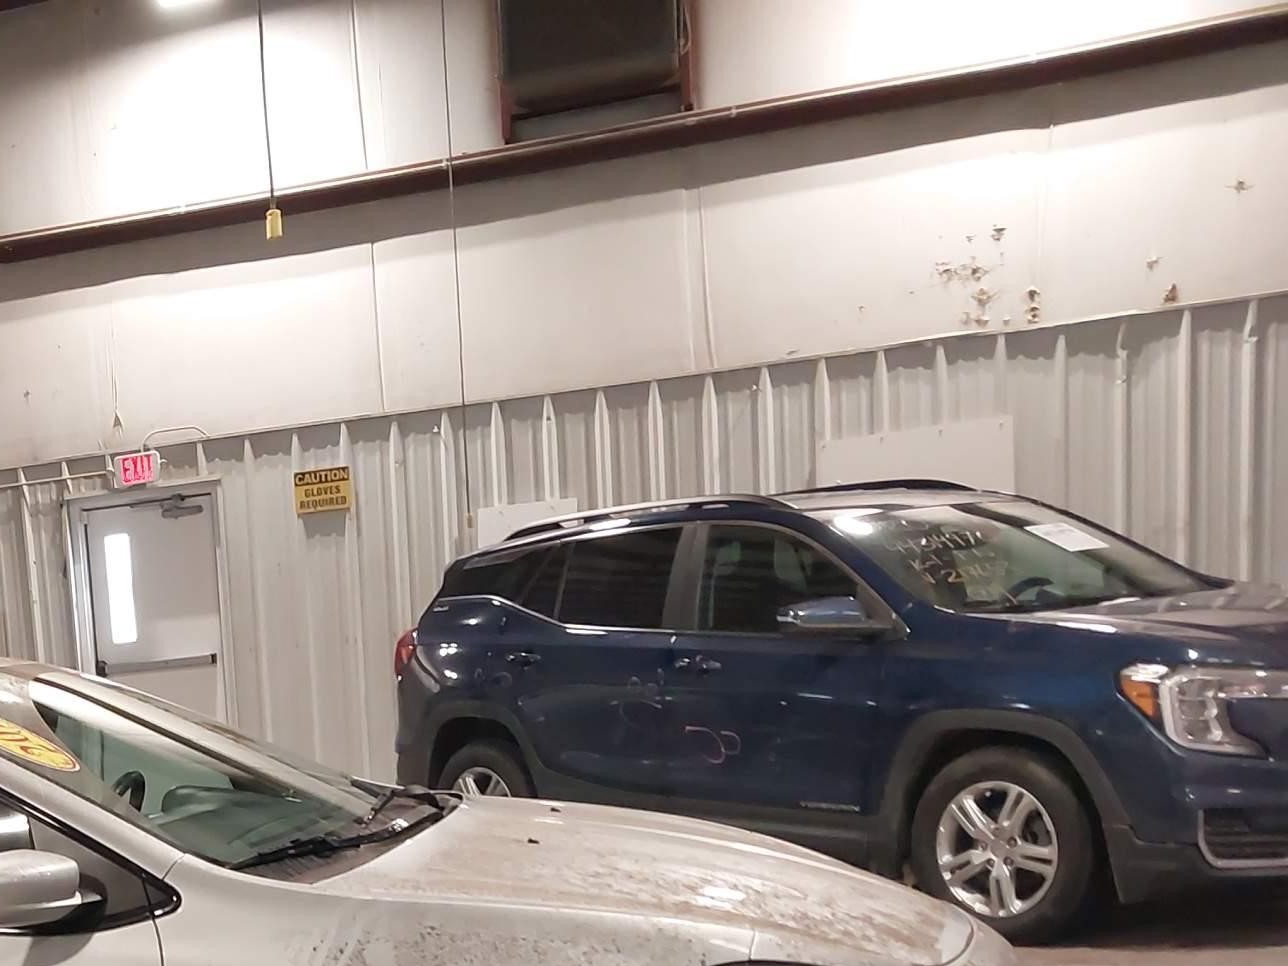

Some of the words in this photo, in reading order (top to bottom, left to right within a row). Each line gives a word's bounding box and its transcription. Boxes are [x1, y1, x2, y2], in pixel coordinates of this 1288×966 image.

[122, 454, 152, 483] EXIT
[295, 468, 348, 485] CAUTION
[304, 485, 341, 498] GLOVES
[299, 496, 347, 510] REQUIRED
